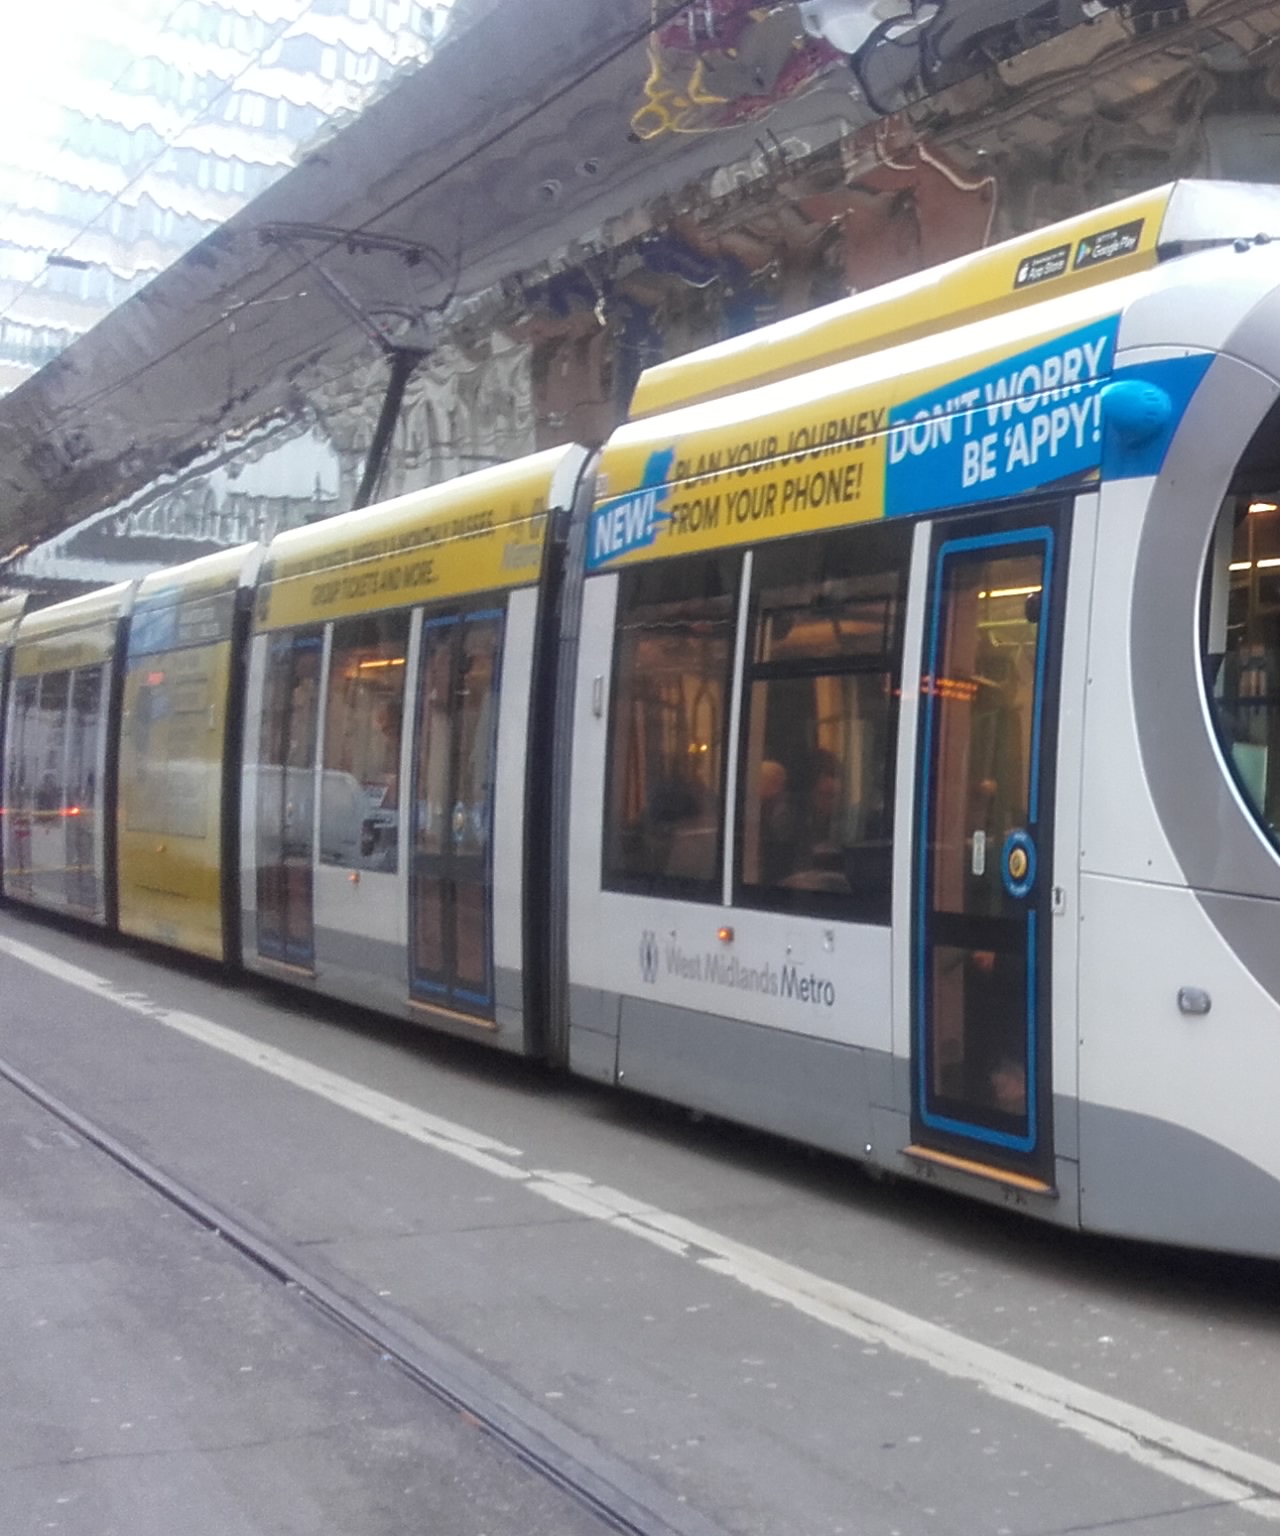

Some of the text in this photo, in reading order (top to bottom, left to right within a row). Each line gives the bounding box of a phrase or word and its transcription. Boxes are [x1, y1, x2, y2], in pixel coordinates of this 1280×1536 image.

[890, 335, 1108, 466] DON'T WORRY
[673, 406, 888, 494] PLAN YOUR JOURNEY
[961, 437, 997, 489] BE
[593, 490, 656, 559] NEW!
[668, 462, 864, 537] FROM YOUR PHONE!
[666, 947, 836, 1007] West Midlands Metro
